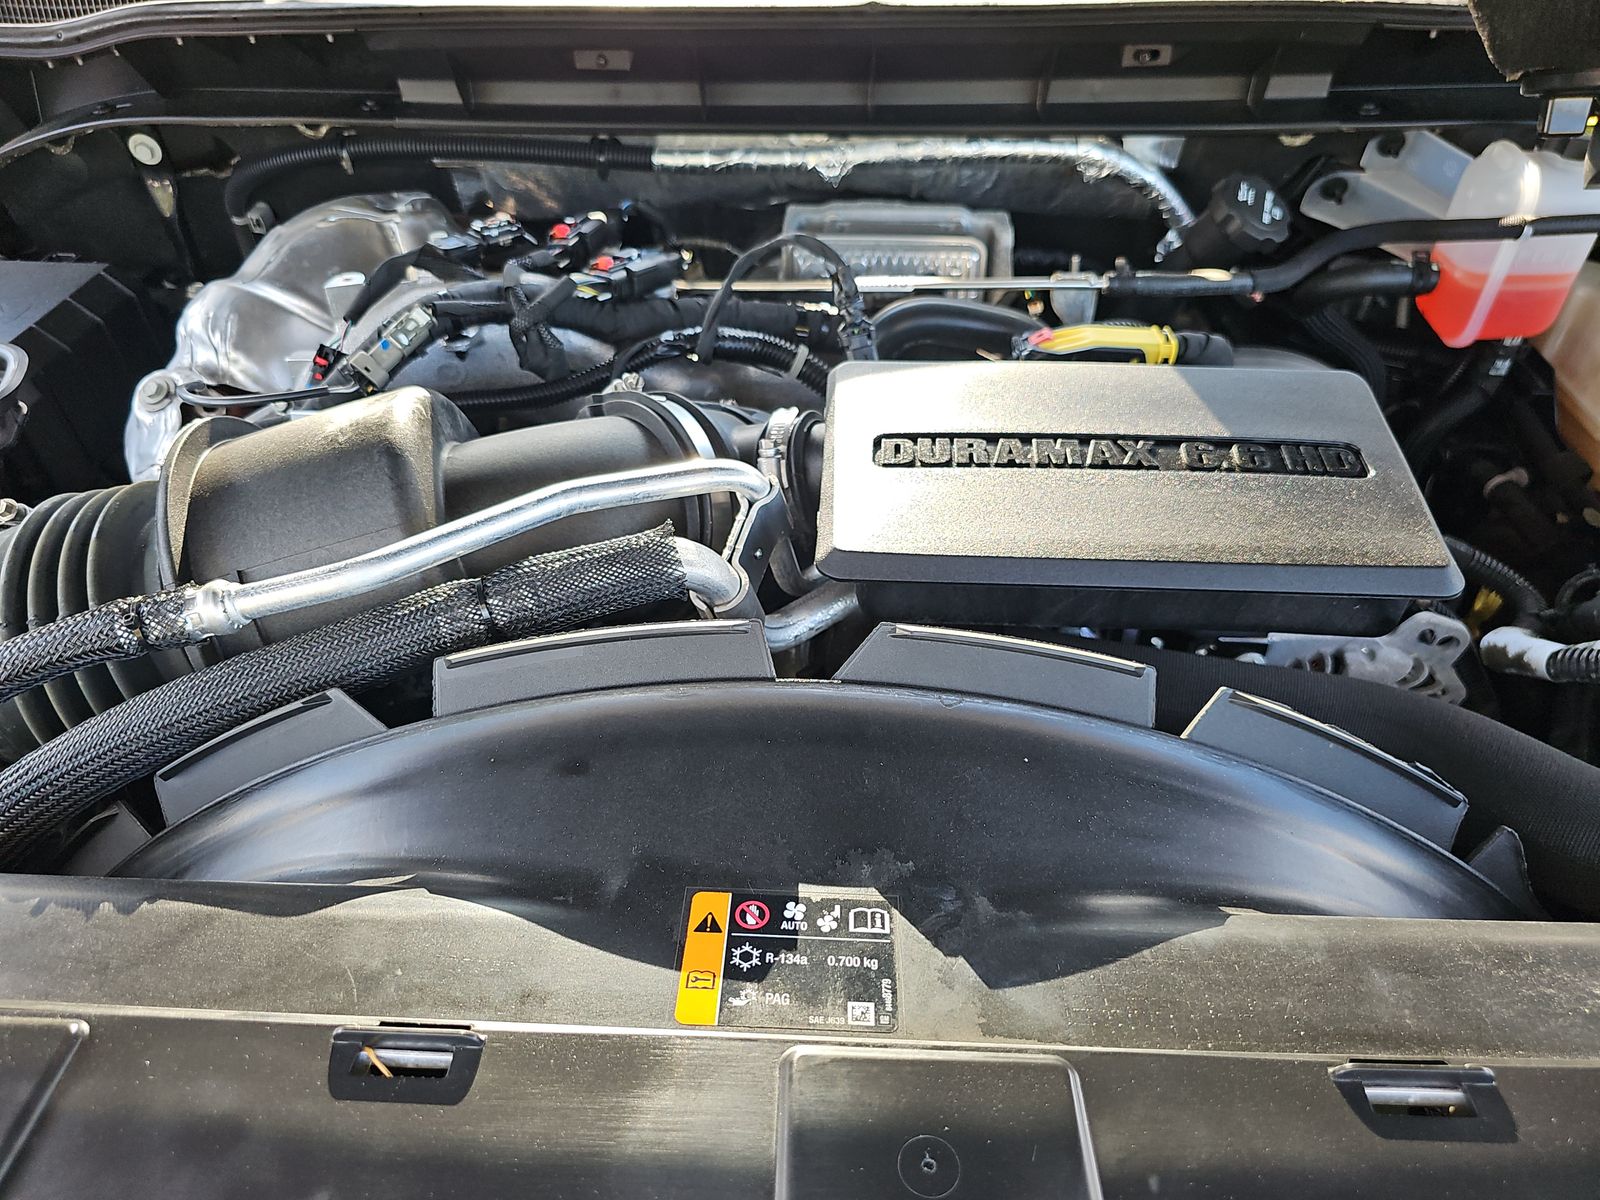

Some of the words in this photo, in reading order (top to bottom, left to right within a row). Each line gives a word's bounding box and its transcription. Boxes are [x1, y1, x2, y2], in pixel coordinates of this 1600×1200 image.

[876, 437, 1161, 468] DURAMAX
[1179, 441, 1272, 471] 6.6
[1281, 444, 1362, 473] HD
[780, 920, 808, 931] AUTO
[765, 952, 808, 965] R-134a
[826, 955, 861, 967] 0.700
[863, 956, 879, 970] kg
[765, 992, 791, 1006] PAG
[808, 1015, 825, 1025] SAE
